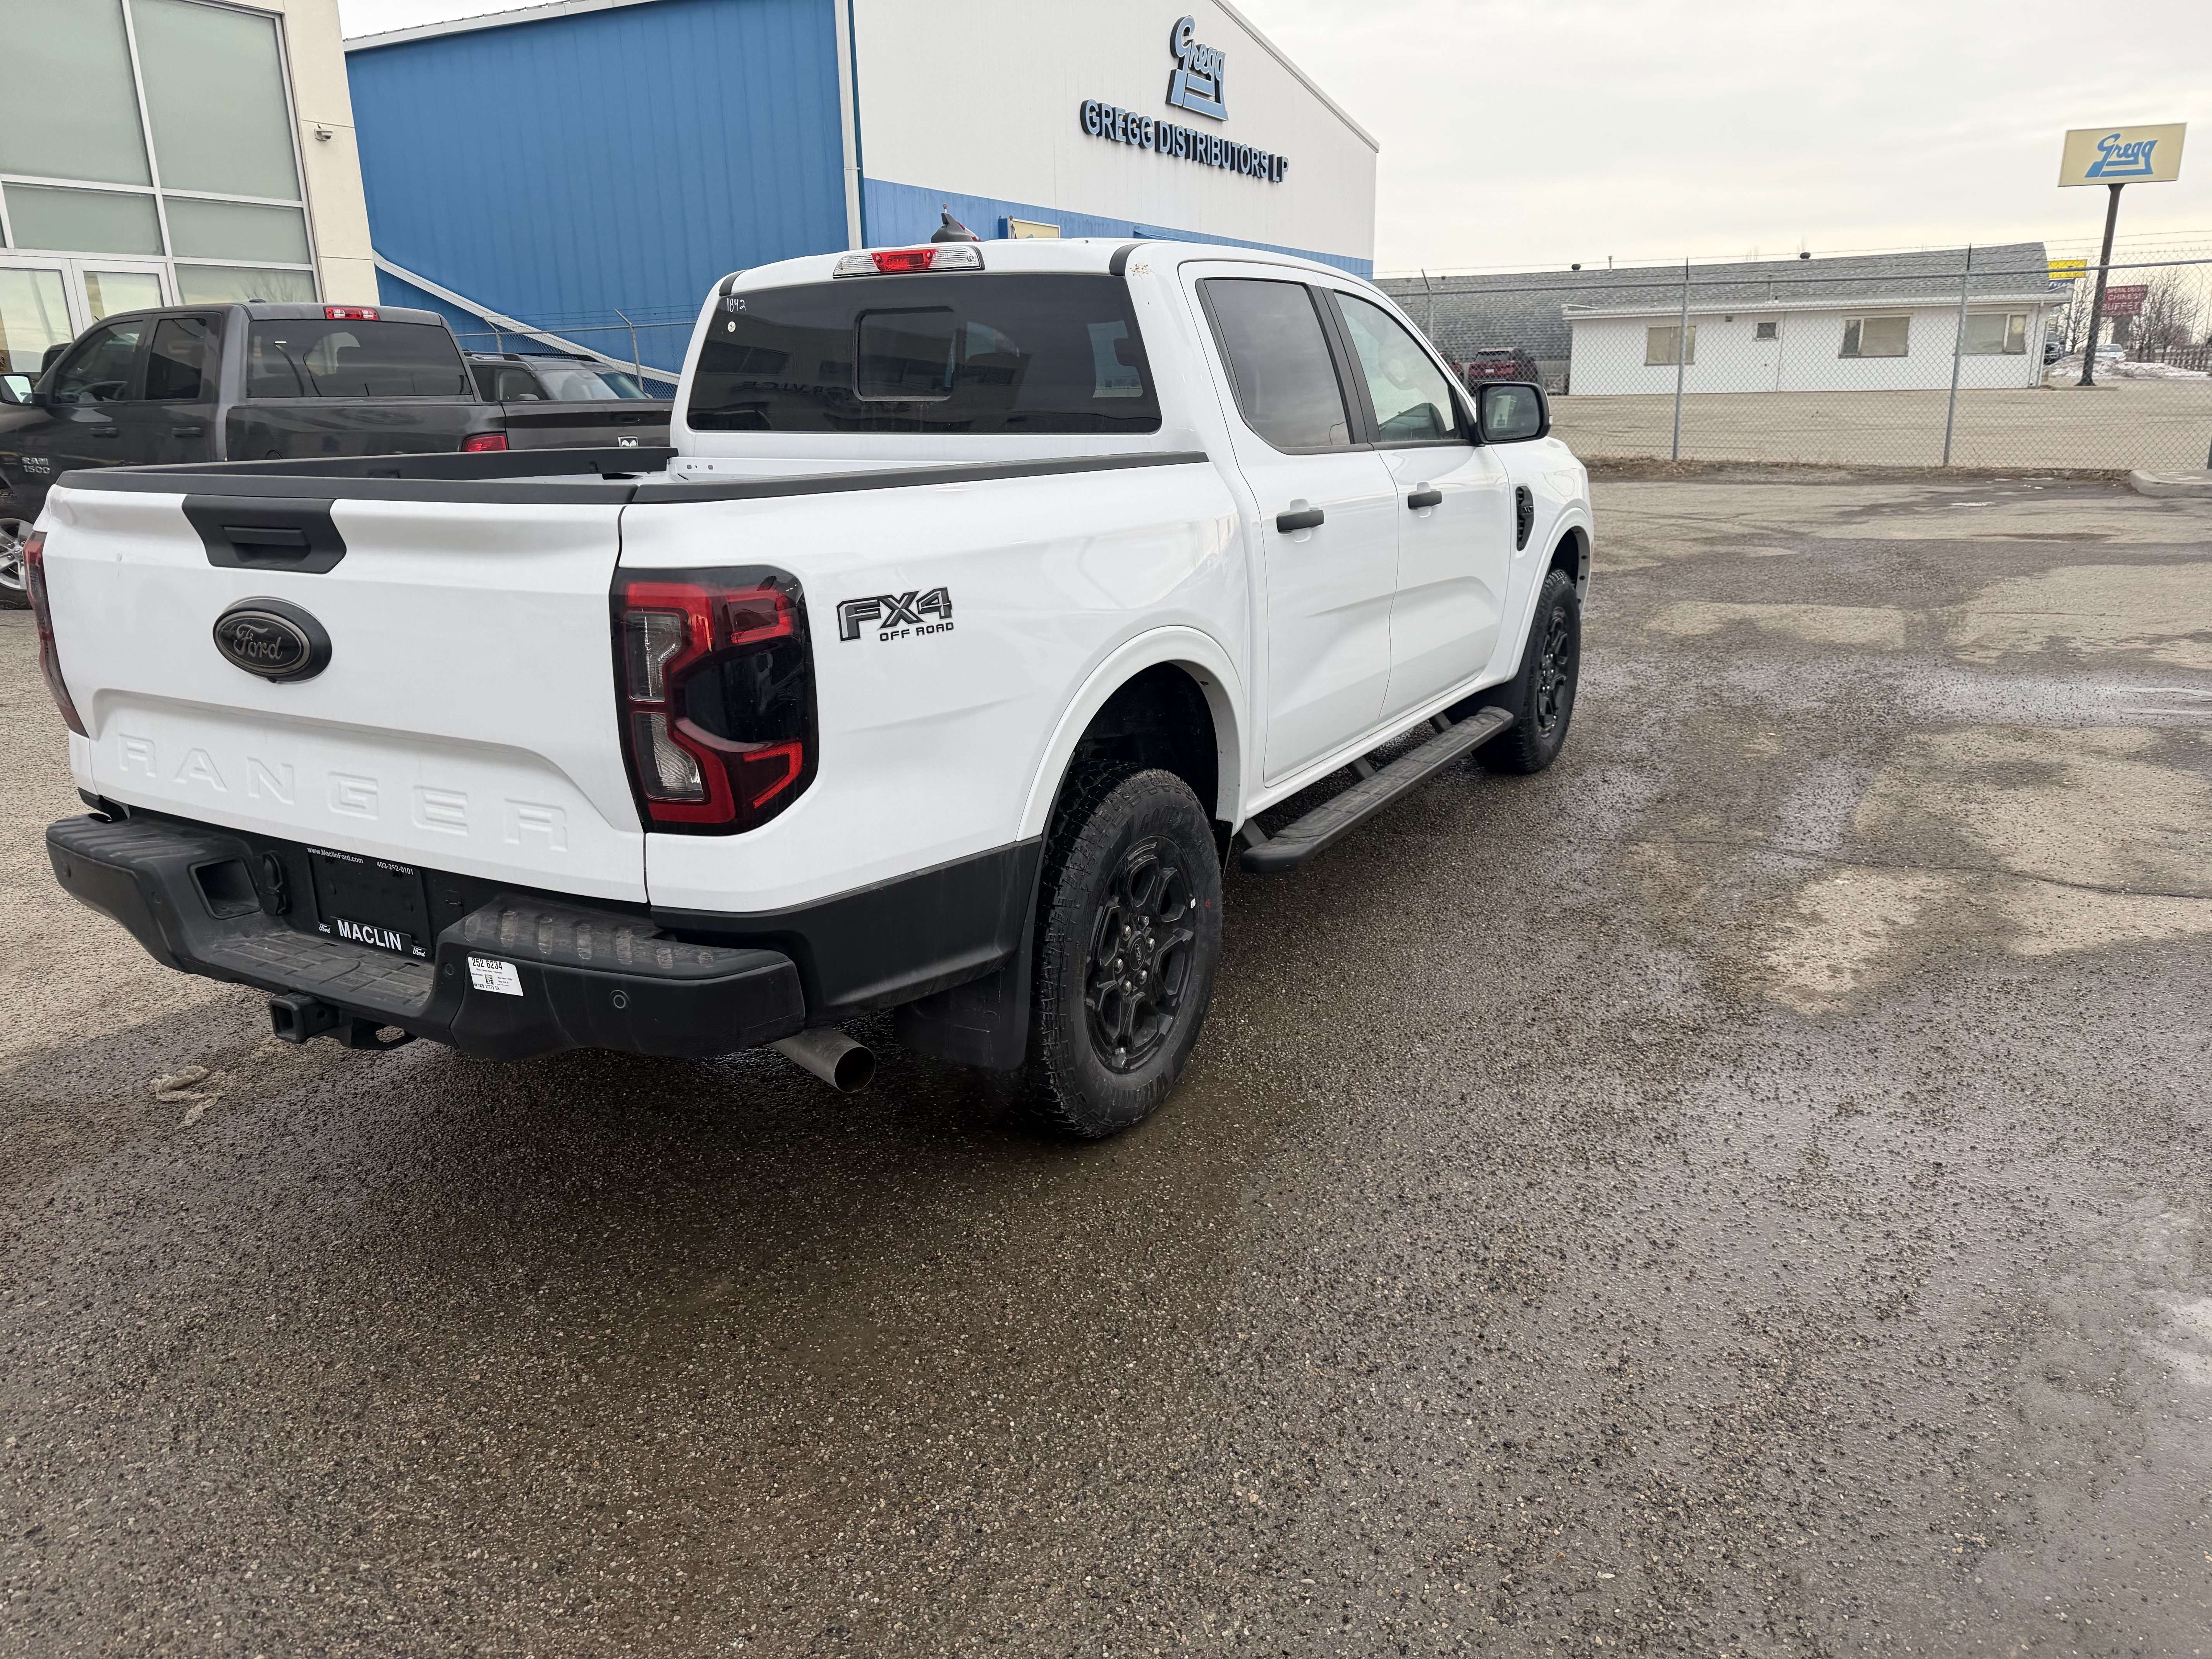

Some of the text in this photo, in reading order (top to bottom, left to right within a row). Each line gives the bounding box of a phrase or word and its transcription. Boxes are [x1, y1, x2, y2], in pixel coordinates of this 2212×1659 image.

[1170, 15, 1227, 93] Gregg
[1080, 99, 1289, 183] GREGG DISTRIBUTORS LP
[2095, 133, 2158, 167] Gregg
[727, 297, 746, 313] 1842
[2102, 302, 2140, 311] BUFFET
[23, 465, 50, 474] 1500
[836, 586, 953, 643] FX4
[880, 622, 954, 641] OFF ROAD
[233, 623, 283, 660] Ford
[117, 733, 568, 852] RANGER
[307, 847, 414, 875] www.MaclinFord.com 403-252-0101
[319, 919, 426, 957] Ford MACLIN Ford
[472, 958, 503, 970] 252 6234
